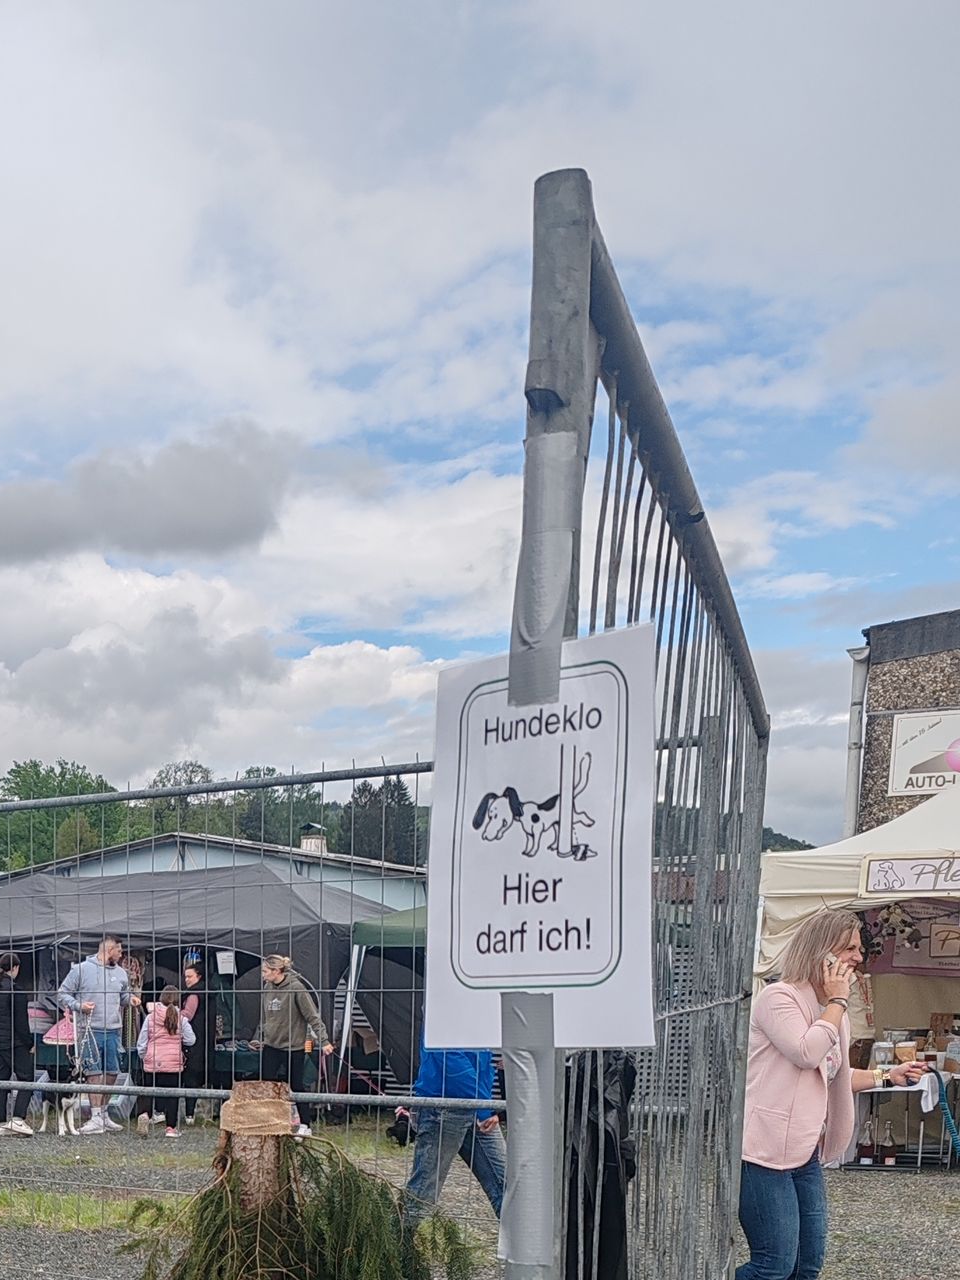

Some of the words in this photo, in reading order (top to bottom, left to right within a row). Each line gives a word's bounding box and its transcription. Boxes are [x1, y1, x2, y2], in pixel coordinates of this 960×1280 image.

[484, 702, 602, 745] Hundeklo
[503, 873, 562, 905] Hier
[476, 921, 527, 954] darf
[538, 917, 591, 952] ich!
